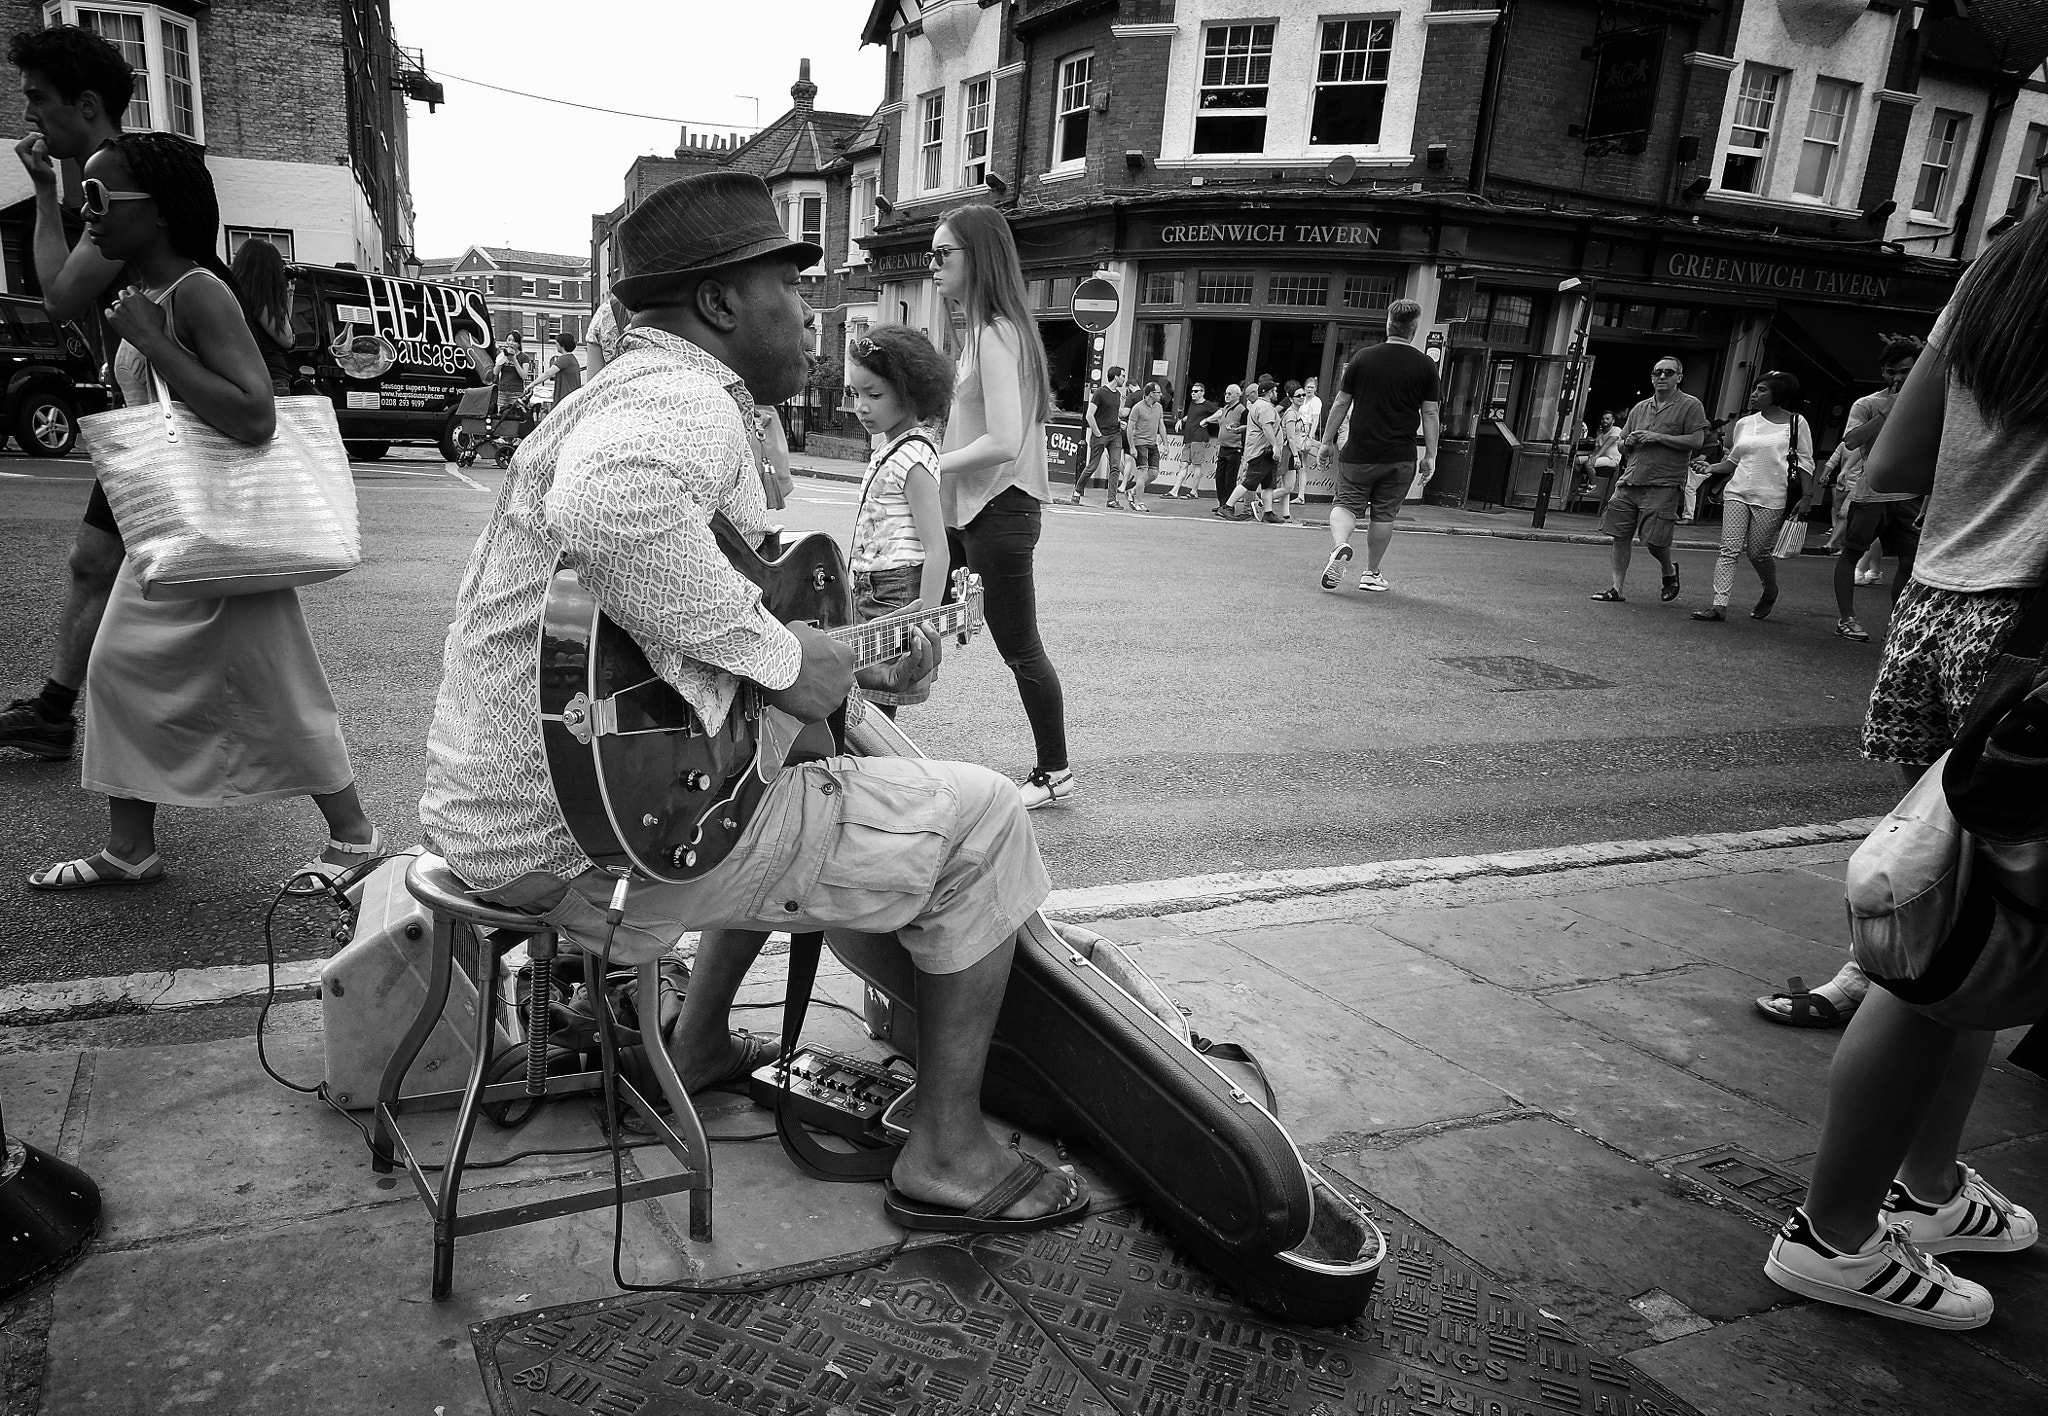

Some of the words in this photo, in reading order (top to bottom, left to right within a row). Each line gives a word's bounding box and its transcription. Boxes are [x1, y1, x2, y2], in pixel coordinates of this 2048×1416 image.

[1161, 224, 1286, 242] GREENWICH
[1295, 225, 1382, 245] TAVERN
[879, 252, 931, 271] GREENWIC
[1668, 253, 1806, 289] GREENWICH
[1815, 270, 1891, 297] TAVERN
[363, 275, 491, 348] HEAP'S
[382, 327, 476, 374] Sausages
[380, 381, 404, 392] Sausage
[405, 384, 427, 392] suppers
[427, 384, 440, 392] here
[380, 398, 397, 406] 0208
[398, 399, 410, 407] 293
[411, 399, 425, 407] 9199
[1346, 1322, 1509, 1381] STINGS
